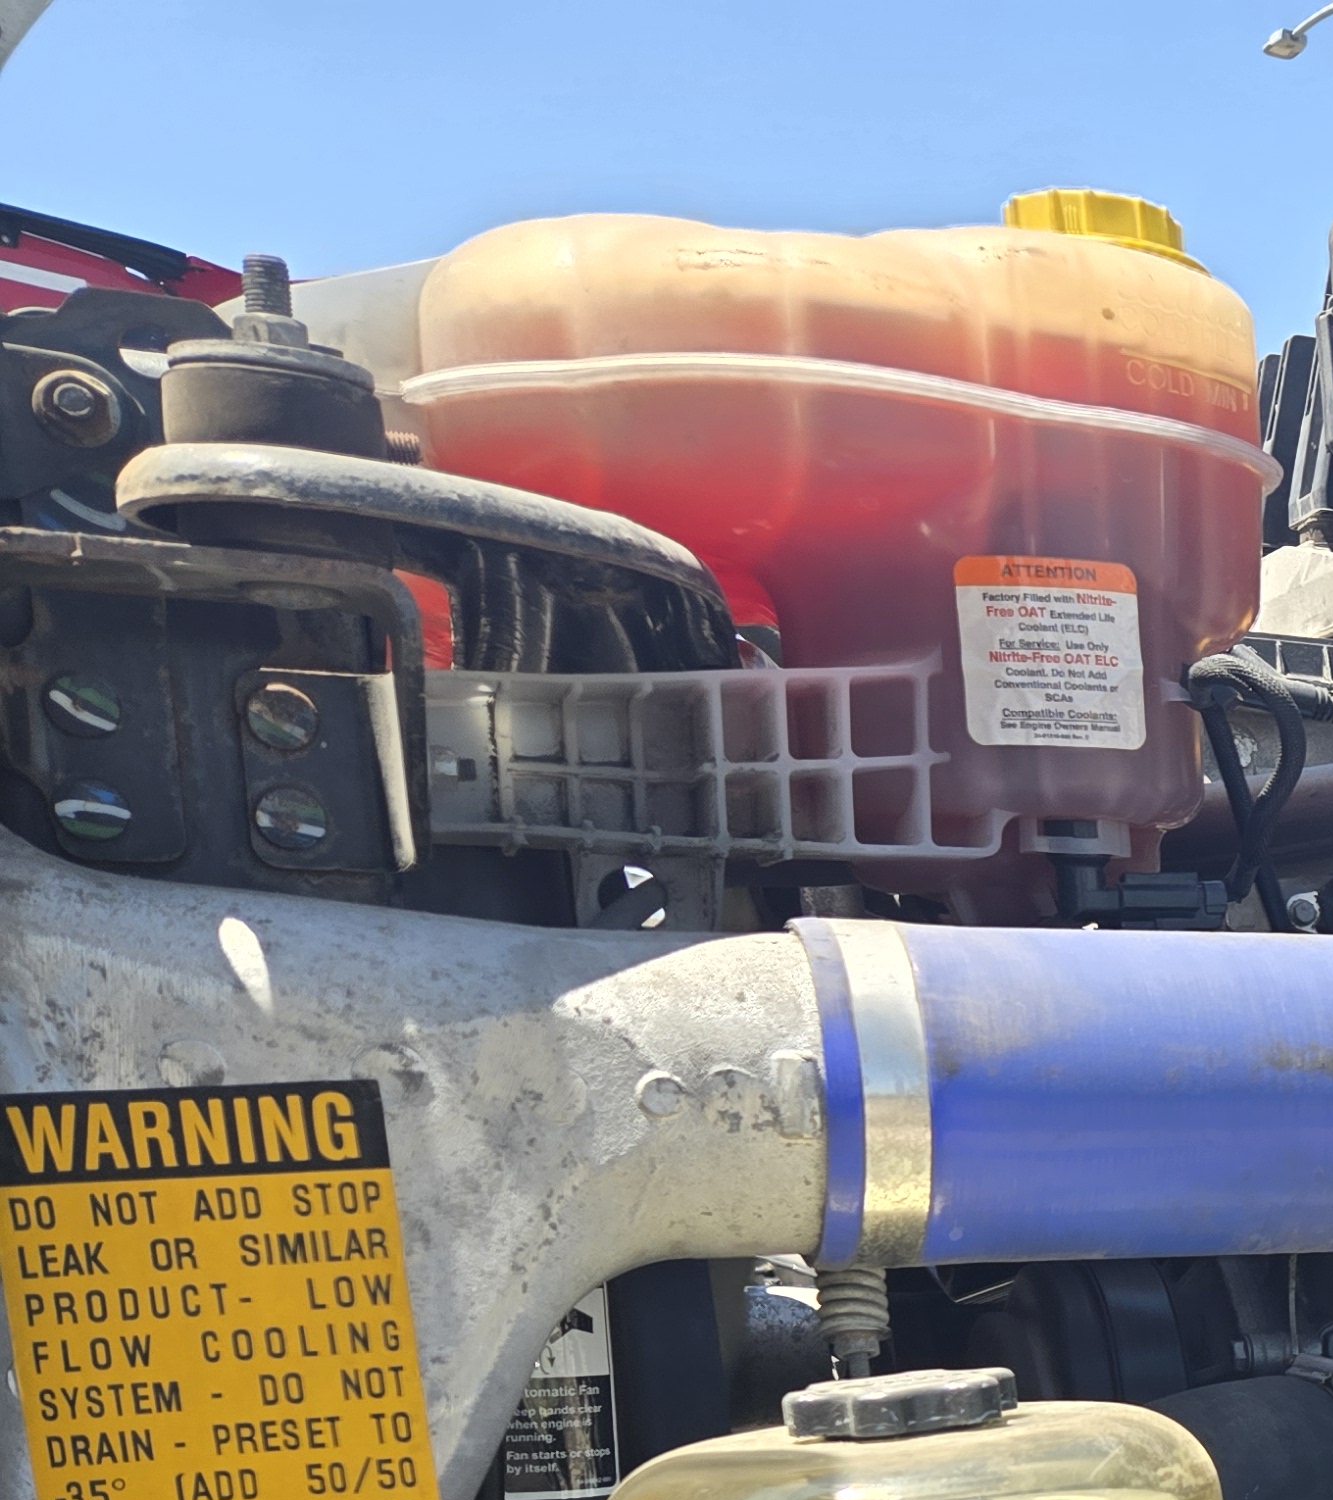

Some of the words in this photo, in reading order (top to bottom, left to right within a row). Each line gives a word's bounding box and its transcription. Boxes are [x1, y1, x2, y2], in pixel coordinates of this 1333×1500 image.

[1126, 359, 1194, 397] COLD
[1001, 564, 1097, 581] ATTENTION
[982, 593, 1021, 603] Factory
[1023, 593, 1051, 602] Filled
[1053, 595, 1075, 603] with
[1076, 593, 1117, 606] Nitrite-
[986, 605, 1014, 617] Free
[1018, 606, 1047, 618] OAT
[1050, 610, 1097, 621] Extended
[1098, 612, 1115, 623] Life
[1018, 622, 1059, 632] Coolant
[1060, 624, 1089, 635] (ELC)
[998, 639, 1016, 649] For
[1018, 639, 1060, 650] Service:
[1065, 641, 1085, 651] Use
[1087, 642, 1109, 652] Only
[989, 651, 1060, 663] Nitrite-Free
[1064, 654, 1091, 665] OAT
[1094, 656, 1119, 667] ELC
[1051, 668, 1065, 678] Do
[1068, 669, 1086, 679] Not
[1088, 670, 1107, 680] Add
[994, 679, 1062, 691] Conventional
[1064, 682, 1108, 692] Coolants
[1109, 685, 1118, 693] or
[1044, 693, 1074, 703] SCAs
[1001, 708, 1065, 721] Compatible
[1068, 710, 1118, 721] Coolants:
[1020, 721, 1052, 732] Engine
[1054, 723, 1089, 732] Owners
[1091, 724, 1121, 734] Manual
[6, 1091, 362, 1173] WARNING
[8, 1196, 57, 1231] DO
[89, 1191, 158, 1227] NOT
[194, 1187, 262, 1222] ADD
[293, 1180, 381, 1217] STOP
[18, 1242, 109, 1279] LEAK
[150, 1238, 199, 1271] OR
[239, 1228, 390, 1267] SIMILAR
[25, 1283, 252, 1327] PRODUCT-
[306, 1274, 392, 1310] LOW
[32, 1335, 152, 1375] FLOW
[200, 1320, 400, 1362] COOLING
[38, 1381, 183, 1422] SYSTEM
[258, 1372, 305, 1407] DO
[339, 1365, 405, 1400] NOT
[524, 1386, 577, 1399] tomatic
[579, 1385, 600, 1396] Fan
[513, 1406, 536, 1418] eep
[538, 1405, 576, 1415] hands
[578, 1404, 602, 1414] clear
[541, 1418, 580, 1430] engine
[582, 1416, 592, 1427] is
[45, 1429, 155, 1469] DRAIN
[212, 1416, 341, 1456] PRESET
[370, 1411, 412, 1446] TO
[506, 1432, 557, 1444] running.
[506, 1449, 528, 1461] Fan
[531, 1449, 567, 1460] starts
[569, 1449, 581, 1459] or
[584, 1446, 611, 1458] stops
[305, 1456, 417, 1495] 50/50
[507, 1463, 521, 1476] by
[524, 1462, 560, 1474] itself.
